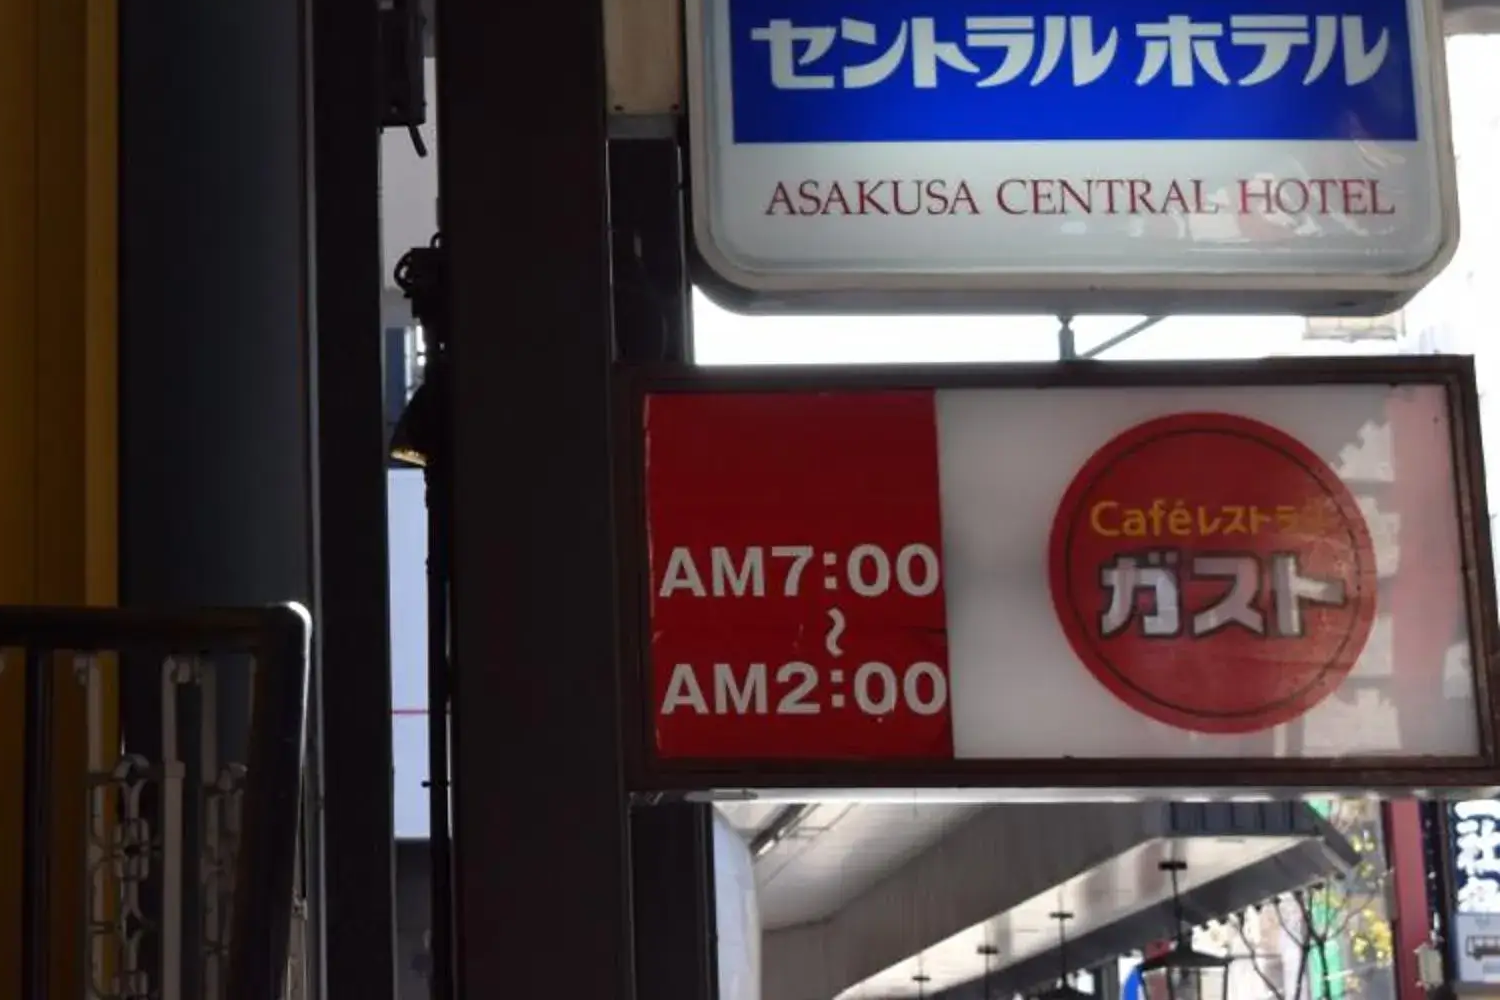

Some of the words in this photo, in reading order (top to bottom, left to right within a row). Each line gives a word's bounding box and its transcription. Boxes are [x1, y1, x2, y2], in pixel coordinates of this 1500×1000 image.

[764, 180, 981, 217] ASAKUSA
[996, 177, 1223, 217] CENTRAL
[1236, 177, 1396, 217] HOTEL
[659, 543, 941, 599] AM7:00
[1100, 549, 1347, 637] ガスト
[660, 660, 949, 716] AM2:00
